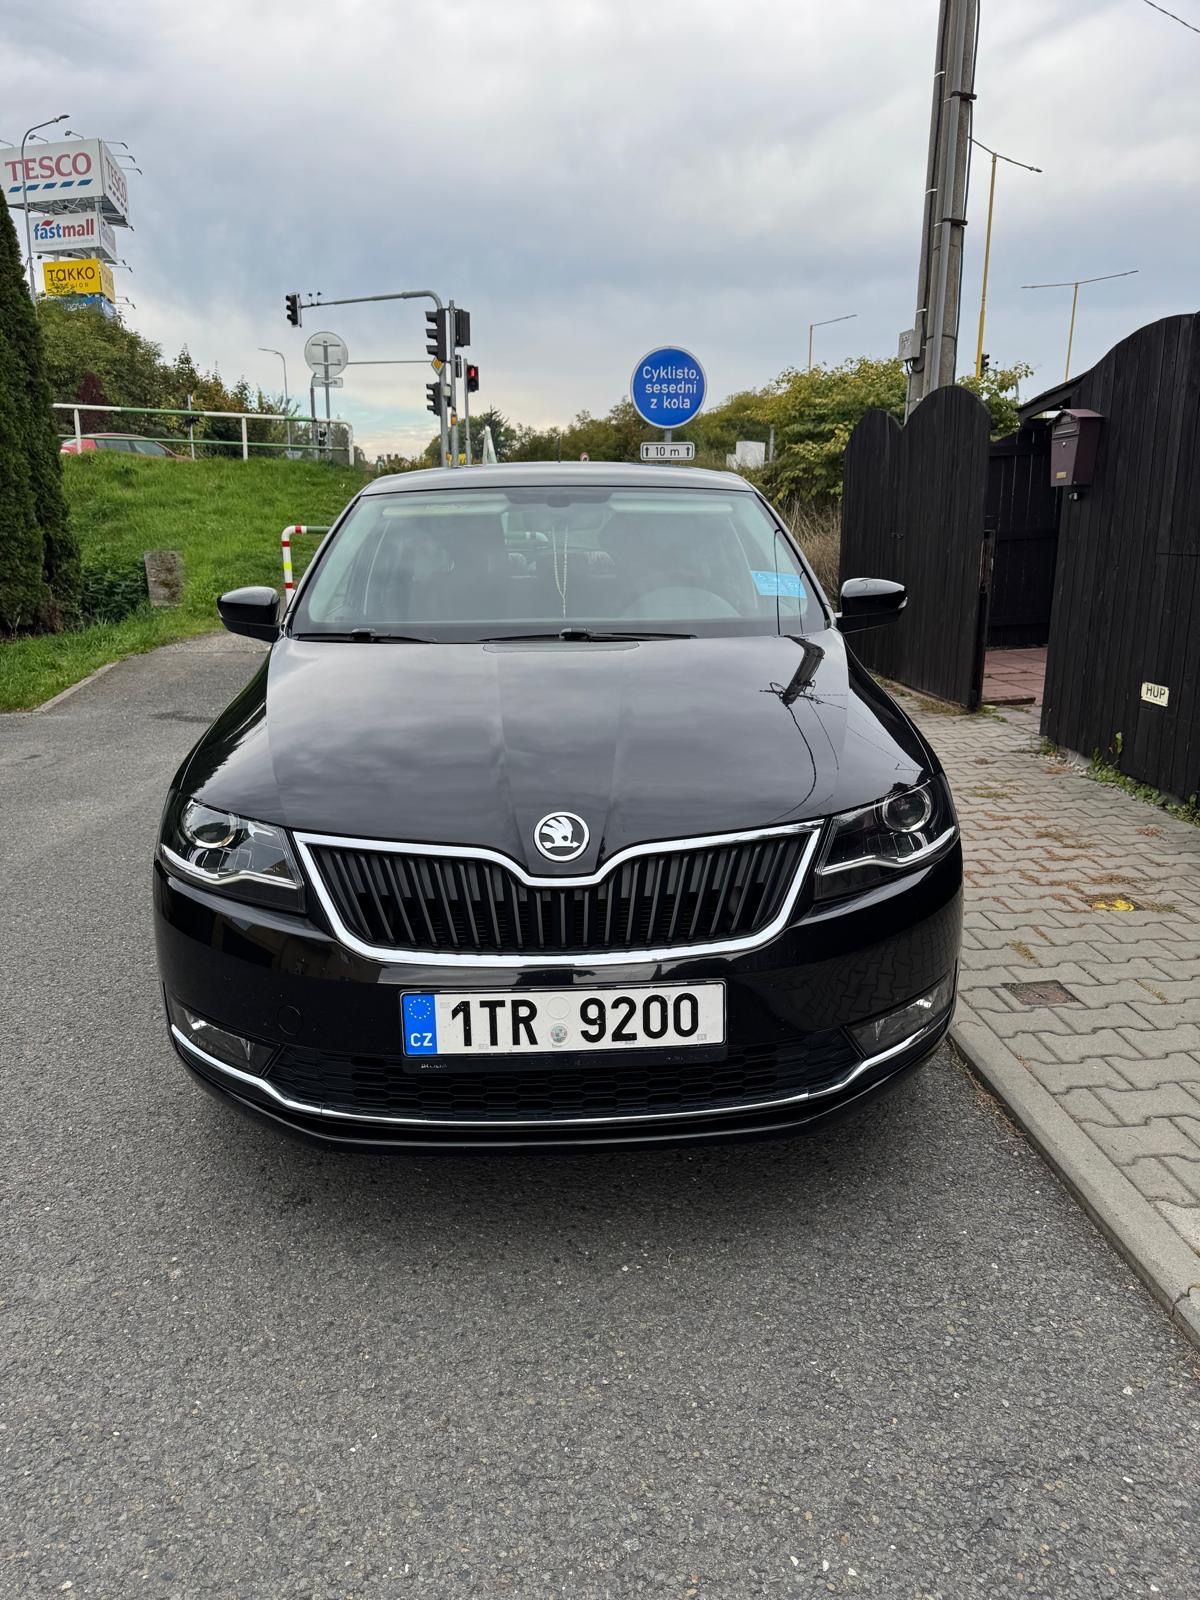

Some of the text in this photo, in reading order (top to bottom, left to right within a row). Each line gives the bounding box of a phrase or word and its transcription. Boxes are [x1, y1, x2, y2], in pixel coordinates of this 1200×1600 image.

[5, 152, 92, 181] TESCO
[34, 218, 95, 240] fastmall
[645, 381, 697, 394] sesedni
[650, 395, 691, 409] z kola
[655, 446, 680, 457] 10 m
[1146, 683, 1166, 700] HUP
[451, 992, 699, 1047] 1TR 9200
[410, 1033, 433, 1047] CZ
